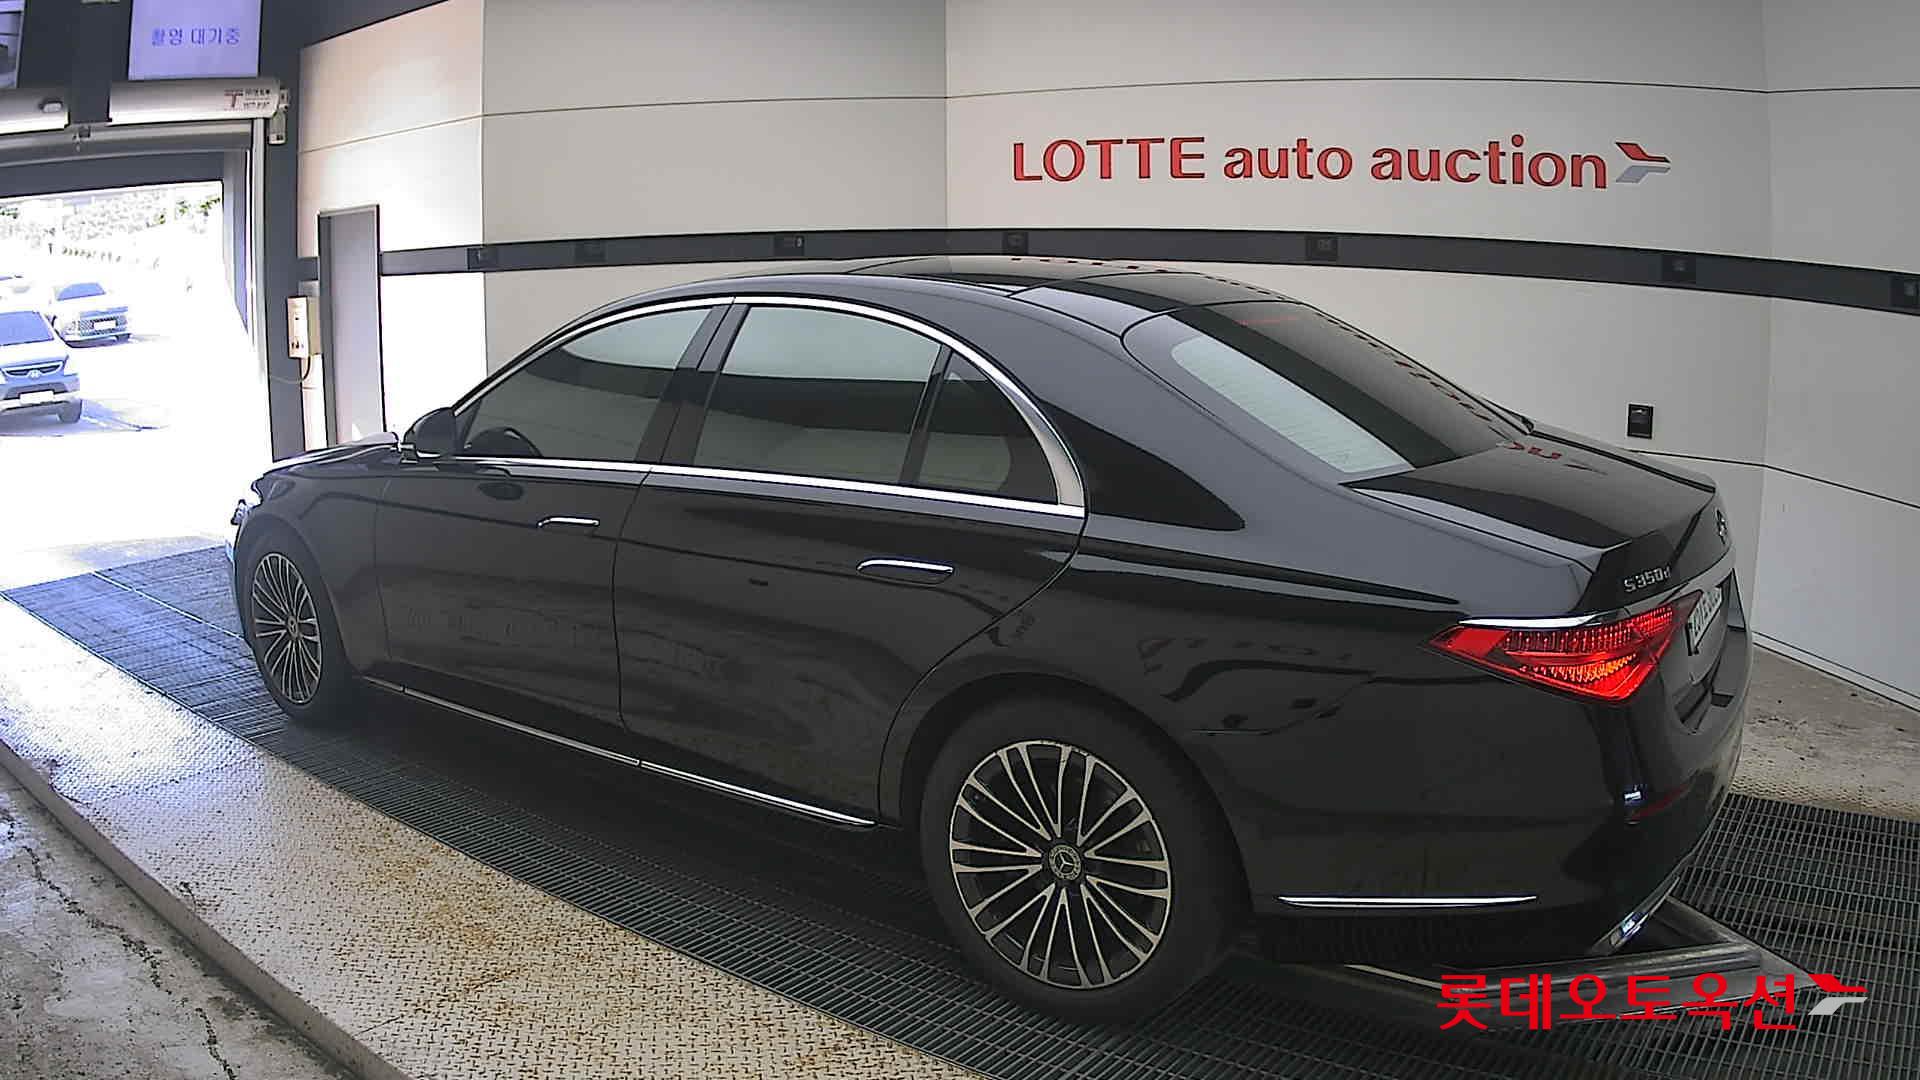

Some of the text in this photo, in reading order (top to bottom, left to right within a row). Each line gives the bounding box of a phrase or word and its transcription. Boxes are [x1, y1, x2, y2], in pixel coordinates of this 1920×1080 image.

[191, 27, 240, 45] 대기중
[1013, 134, 1607, 188] LOTTE auto auction
